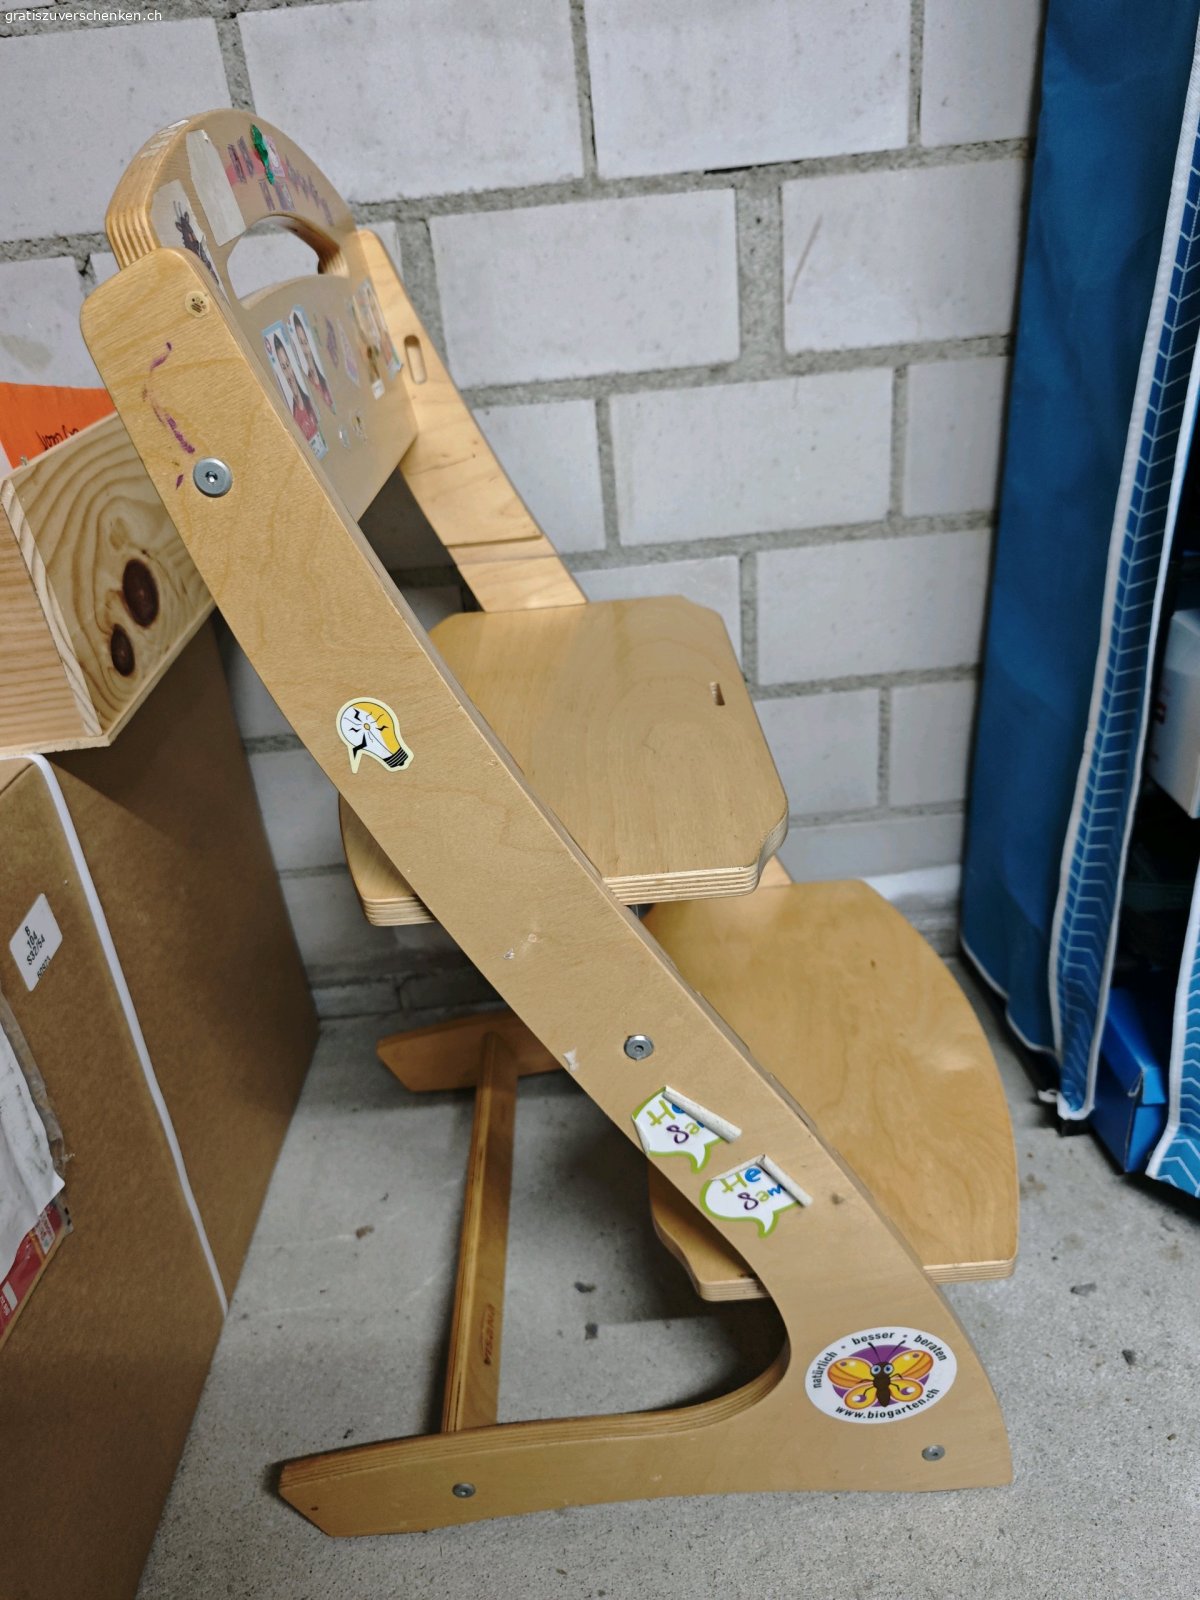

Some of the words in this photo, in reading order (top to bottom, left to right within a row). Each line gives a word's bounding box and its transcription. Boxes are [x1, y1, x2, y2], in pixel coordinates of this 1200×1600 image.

[813, 1351, 837, 1389] natürlich
[851, 1332, 895, 1345] besser
[908, 1334, 947, 1361] beraten
[835, 1388, 940, 1419] www.biogarten.ch
